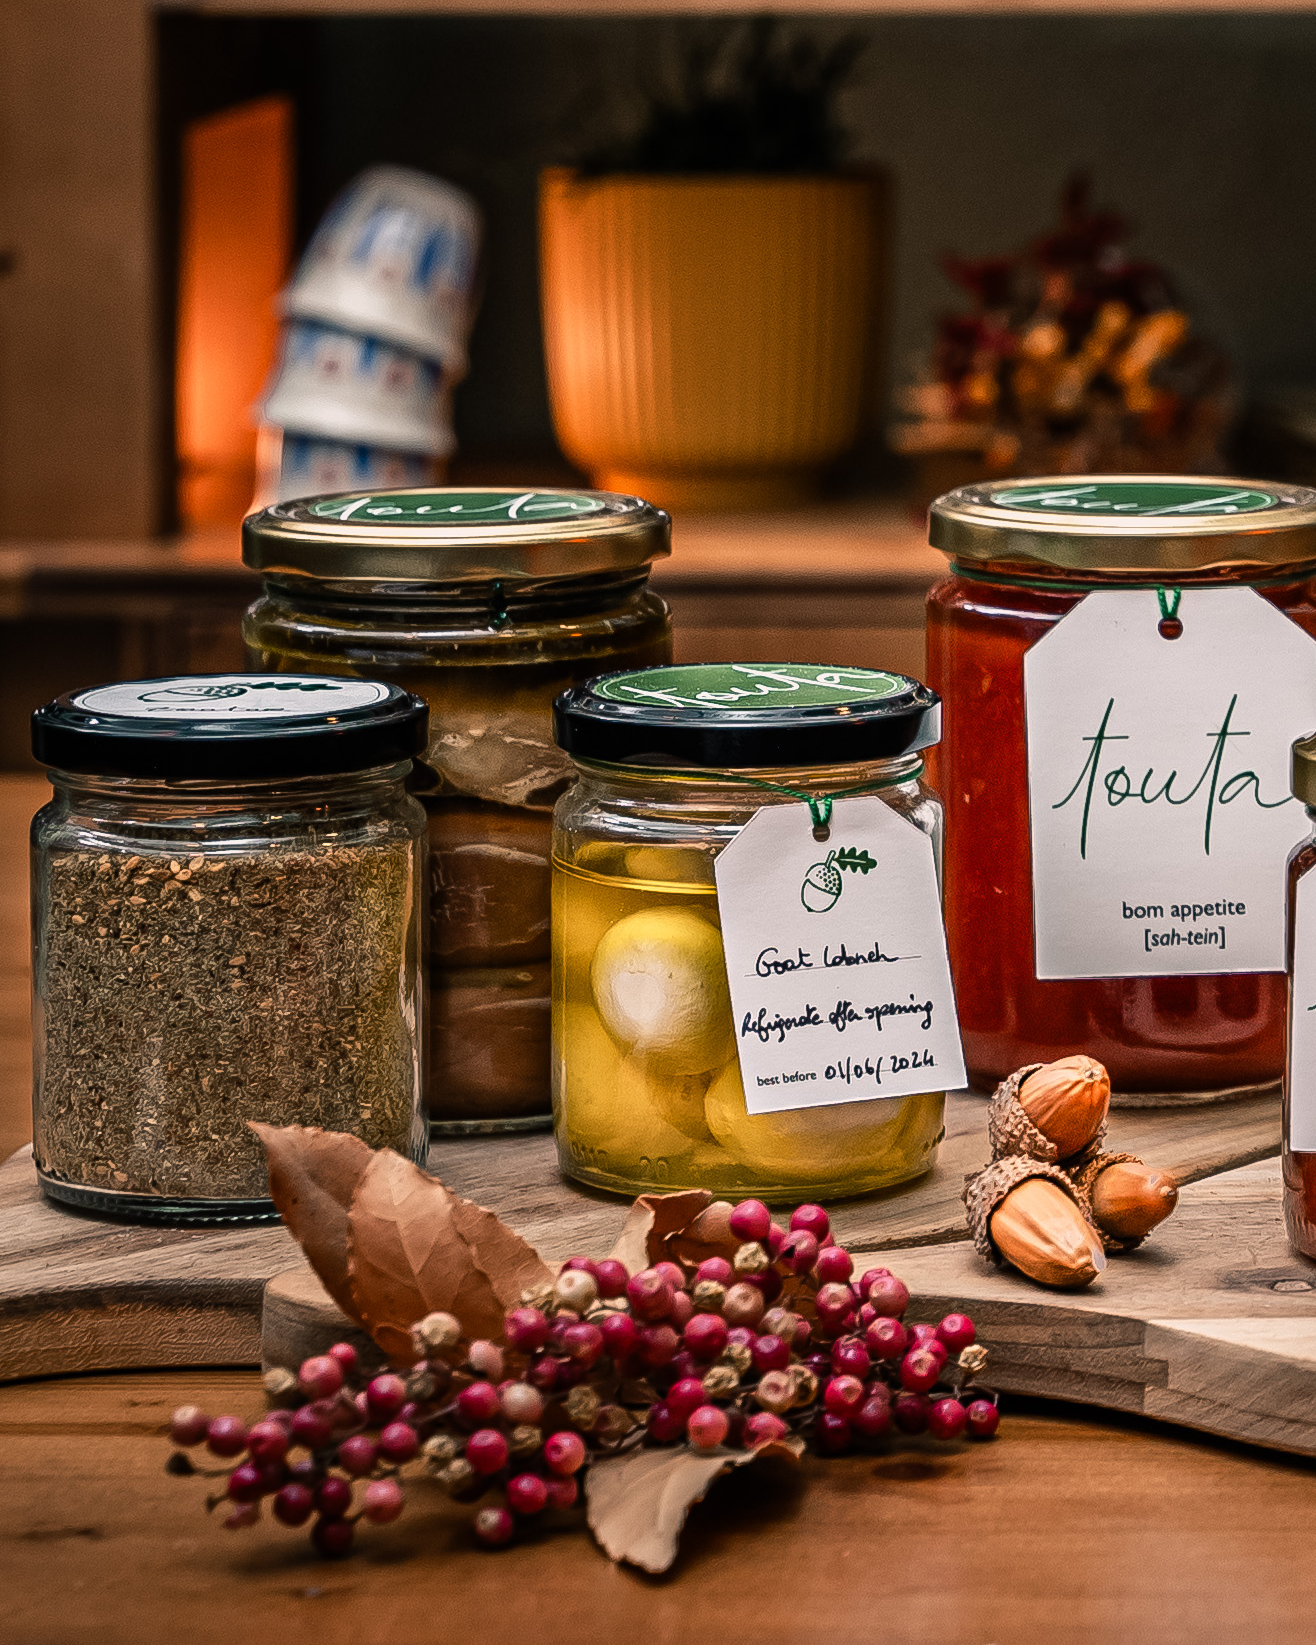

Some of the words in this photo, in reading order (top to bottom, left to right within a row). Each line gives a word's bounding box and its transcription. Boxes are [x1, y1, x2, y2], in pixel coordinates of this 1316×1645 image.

[1052, 693, 1294, 860] touta
[1122, 901, 1164, 919] bom
[1170, 899, 1246, 922] appetite
[1144, 926, 1226, 952] [sah-tein]
[756, 947, 814, 977] Goat
[756, 1075, 780, 1086] best
[782, 1071, 817, 1083] before
